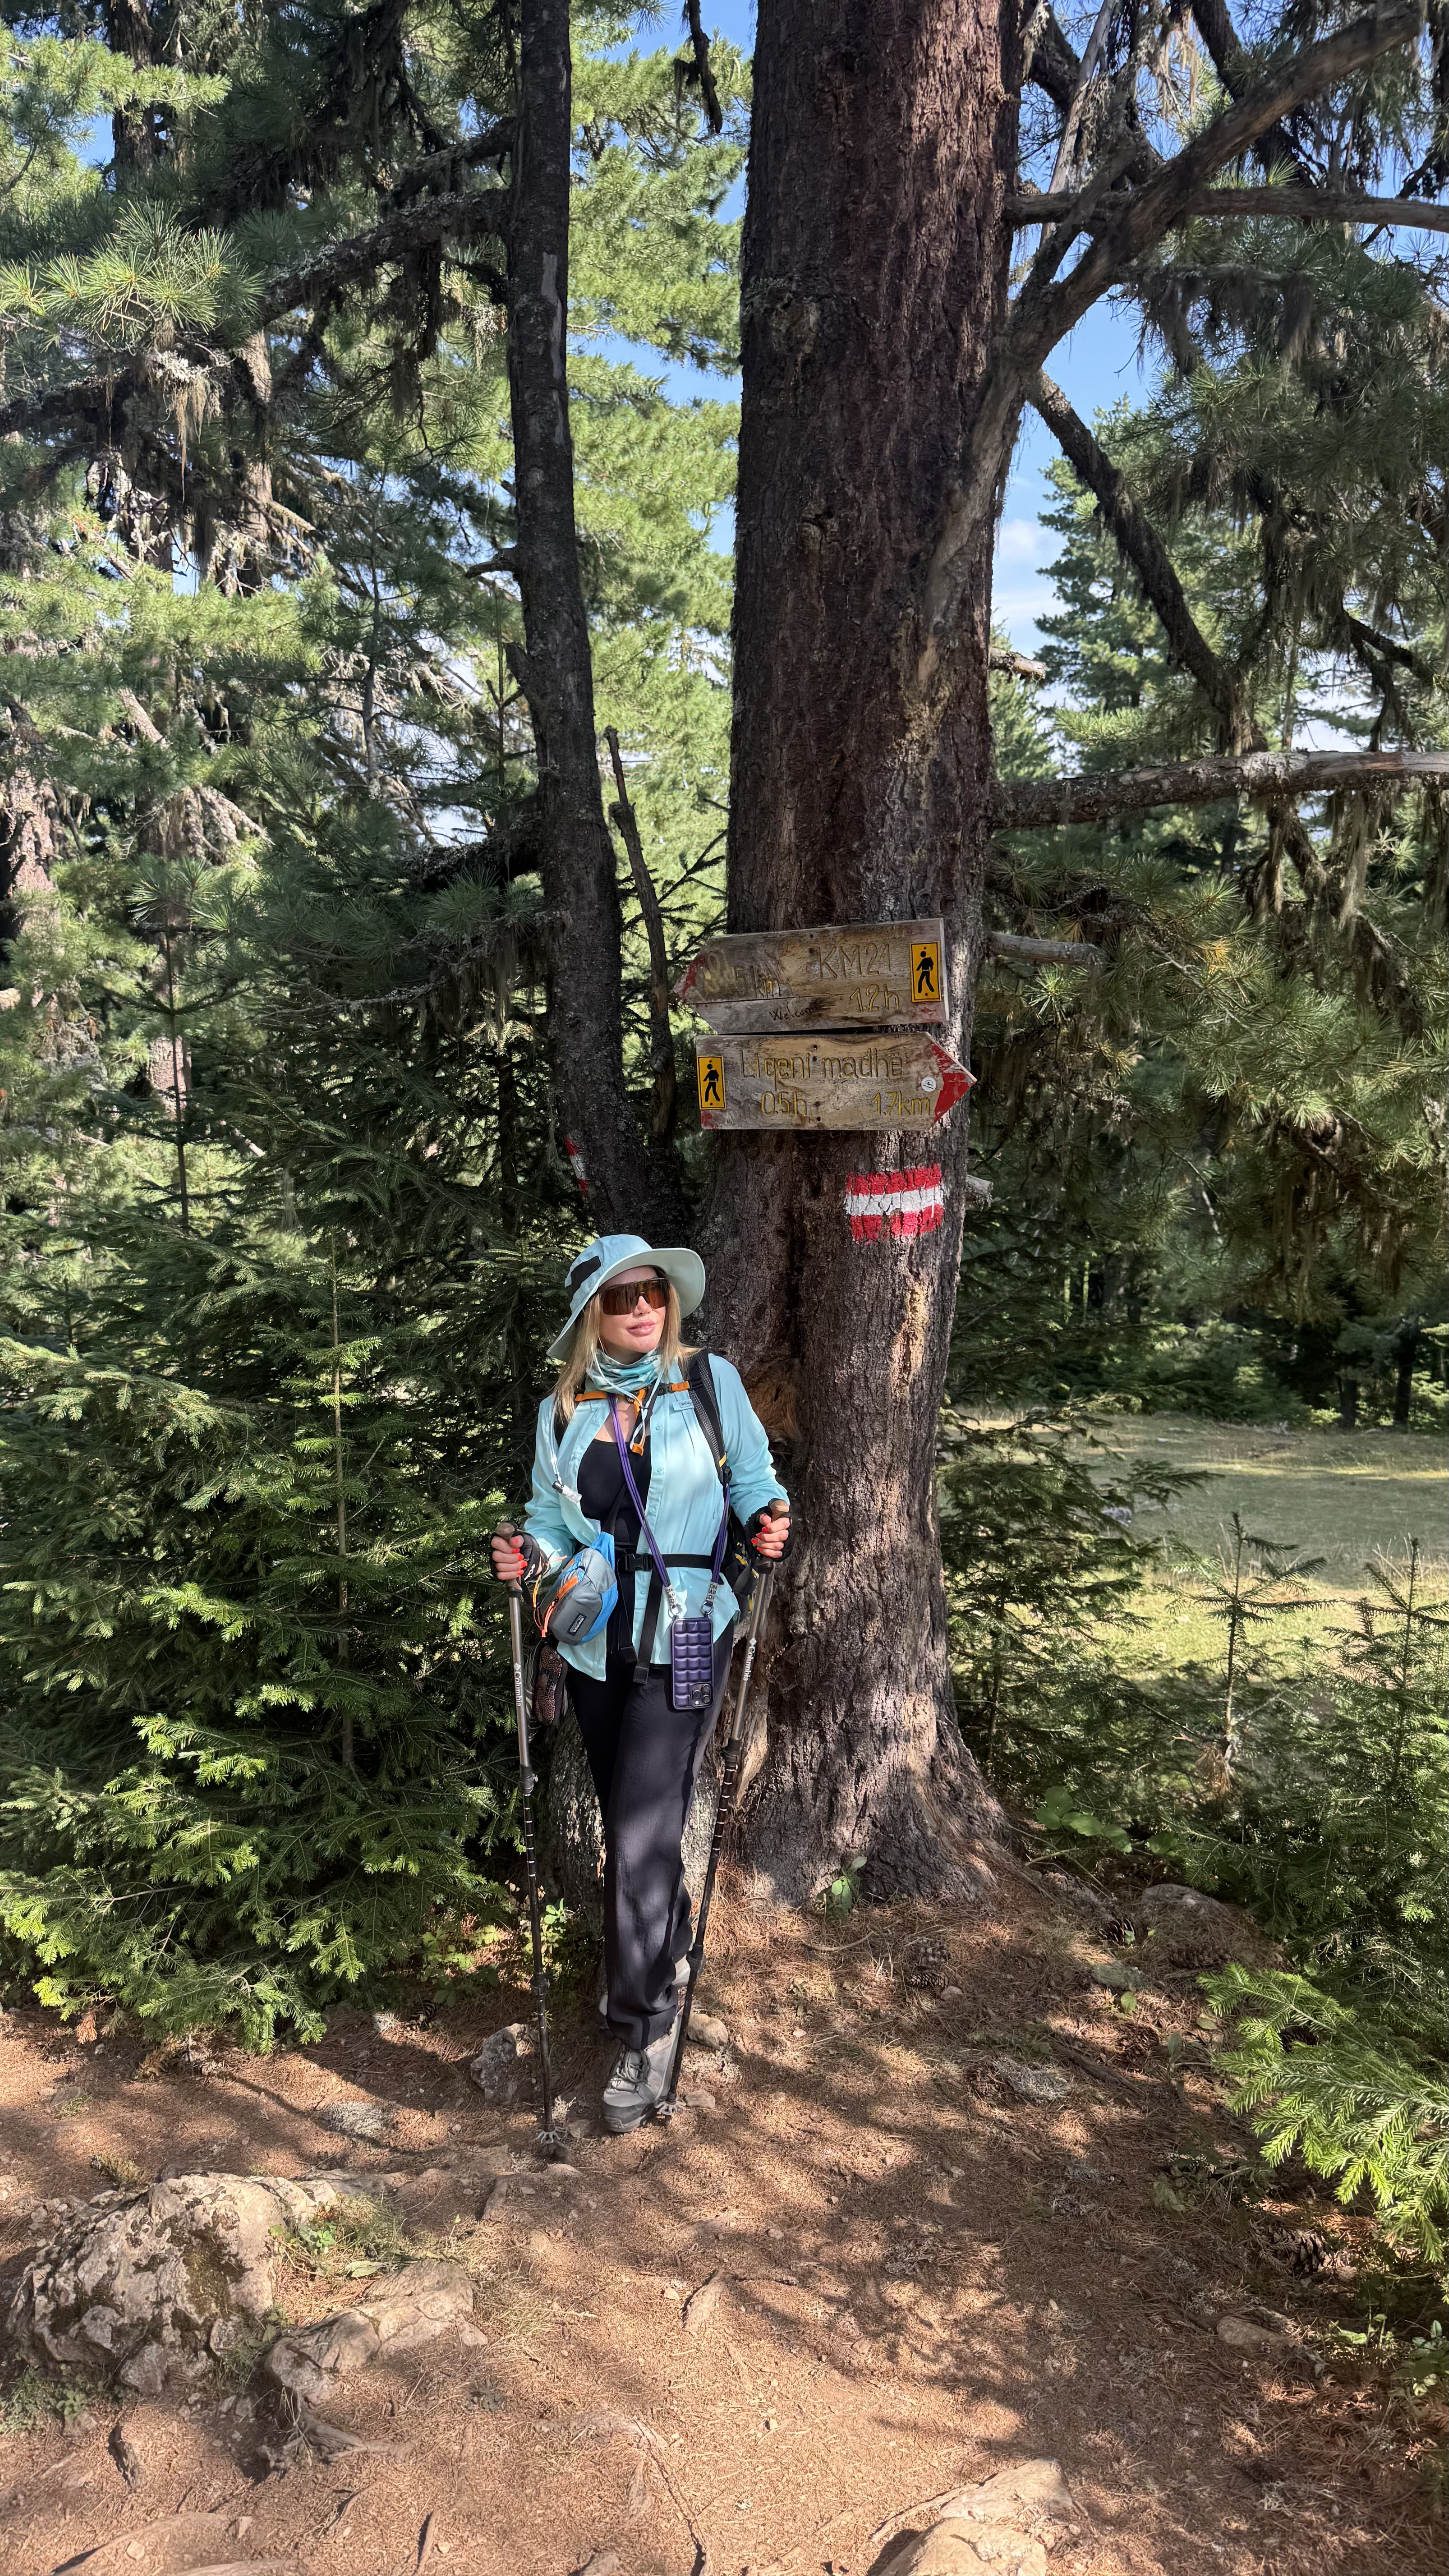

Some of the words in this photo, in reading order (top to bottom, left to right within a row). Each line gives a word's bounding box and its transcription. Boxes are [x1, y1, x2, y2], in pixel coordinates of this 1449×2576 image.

[739, 1049, 811, 1091] Liqeni
[872, 1090, 930, 1116] 1.7km
[743, 1646, 755, 1681] Columbia
[514, 1671, 522, 1707] Columbia
